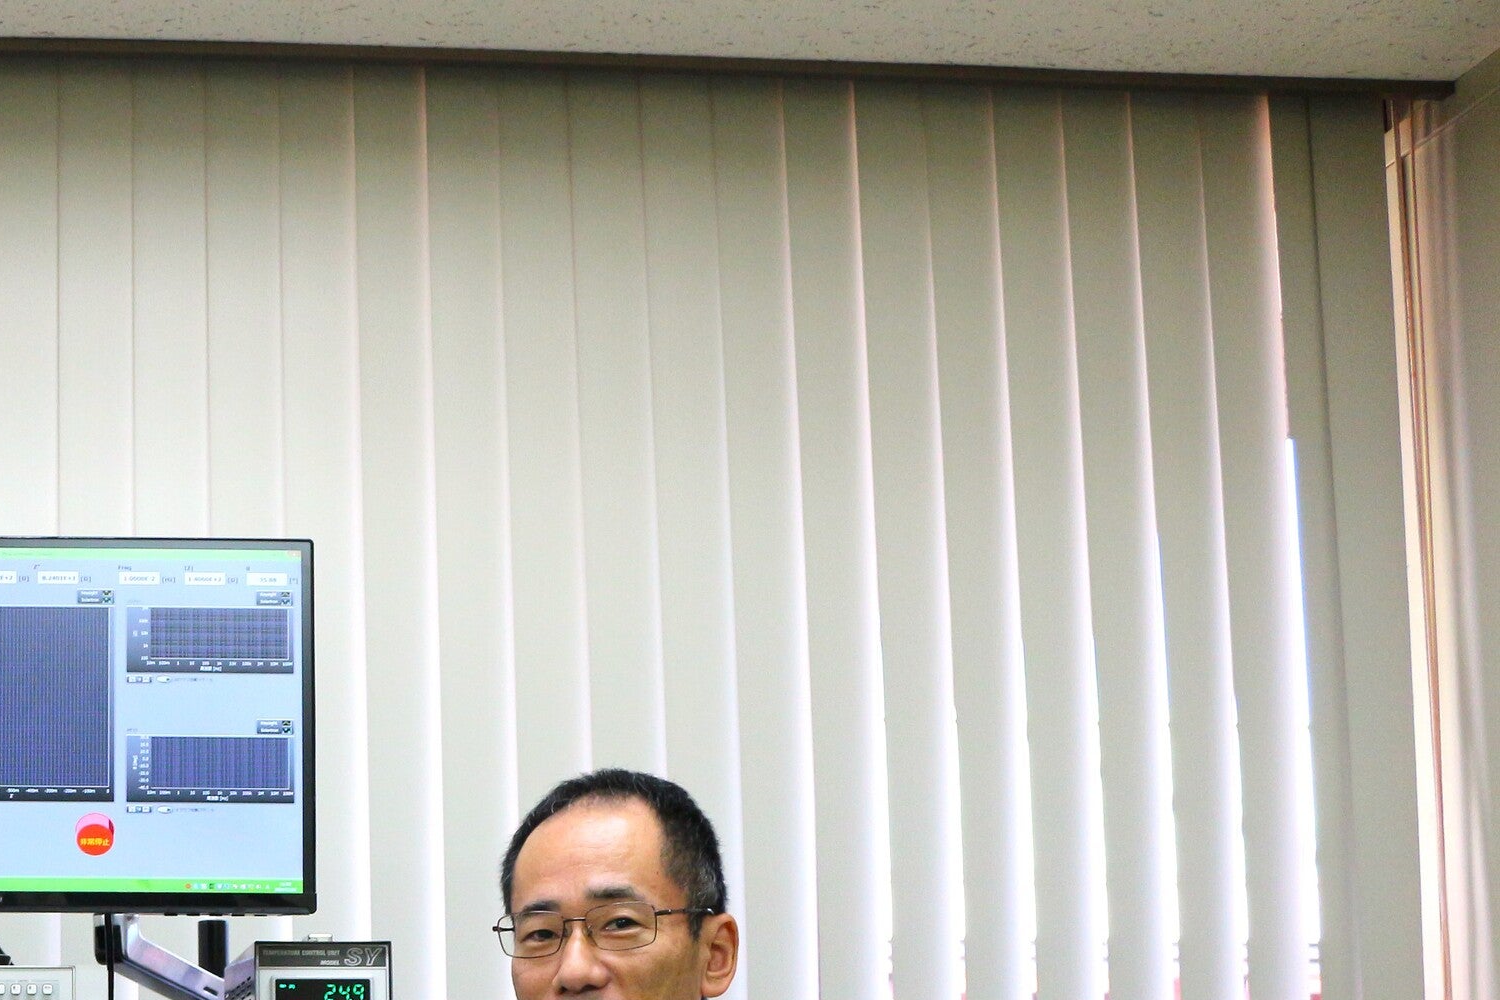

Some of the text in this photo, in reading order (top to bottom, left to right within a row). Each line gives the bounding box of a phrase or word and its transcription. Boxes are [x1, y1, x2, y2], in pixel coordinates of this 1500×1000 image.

[80, 837, 110, 847] 非常停止
[344, 947, 382, 966] SY
